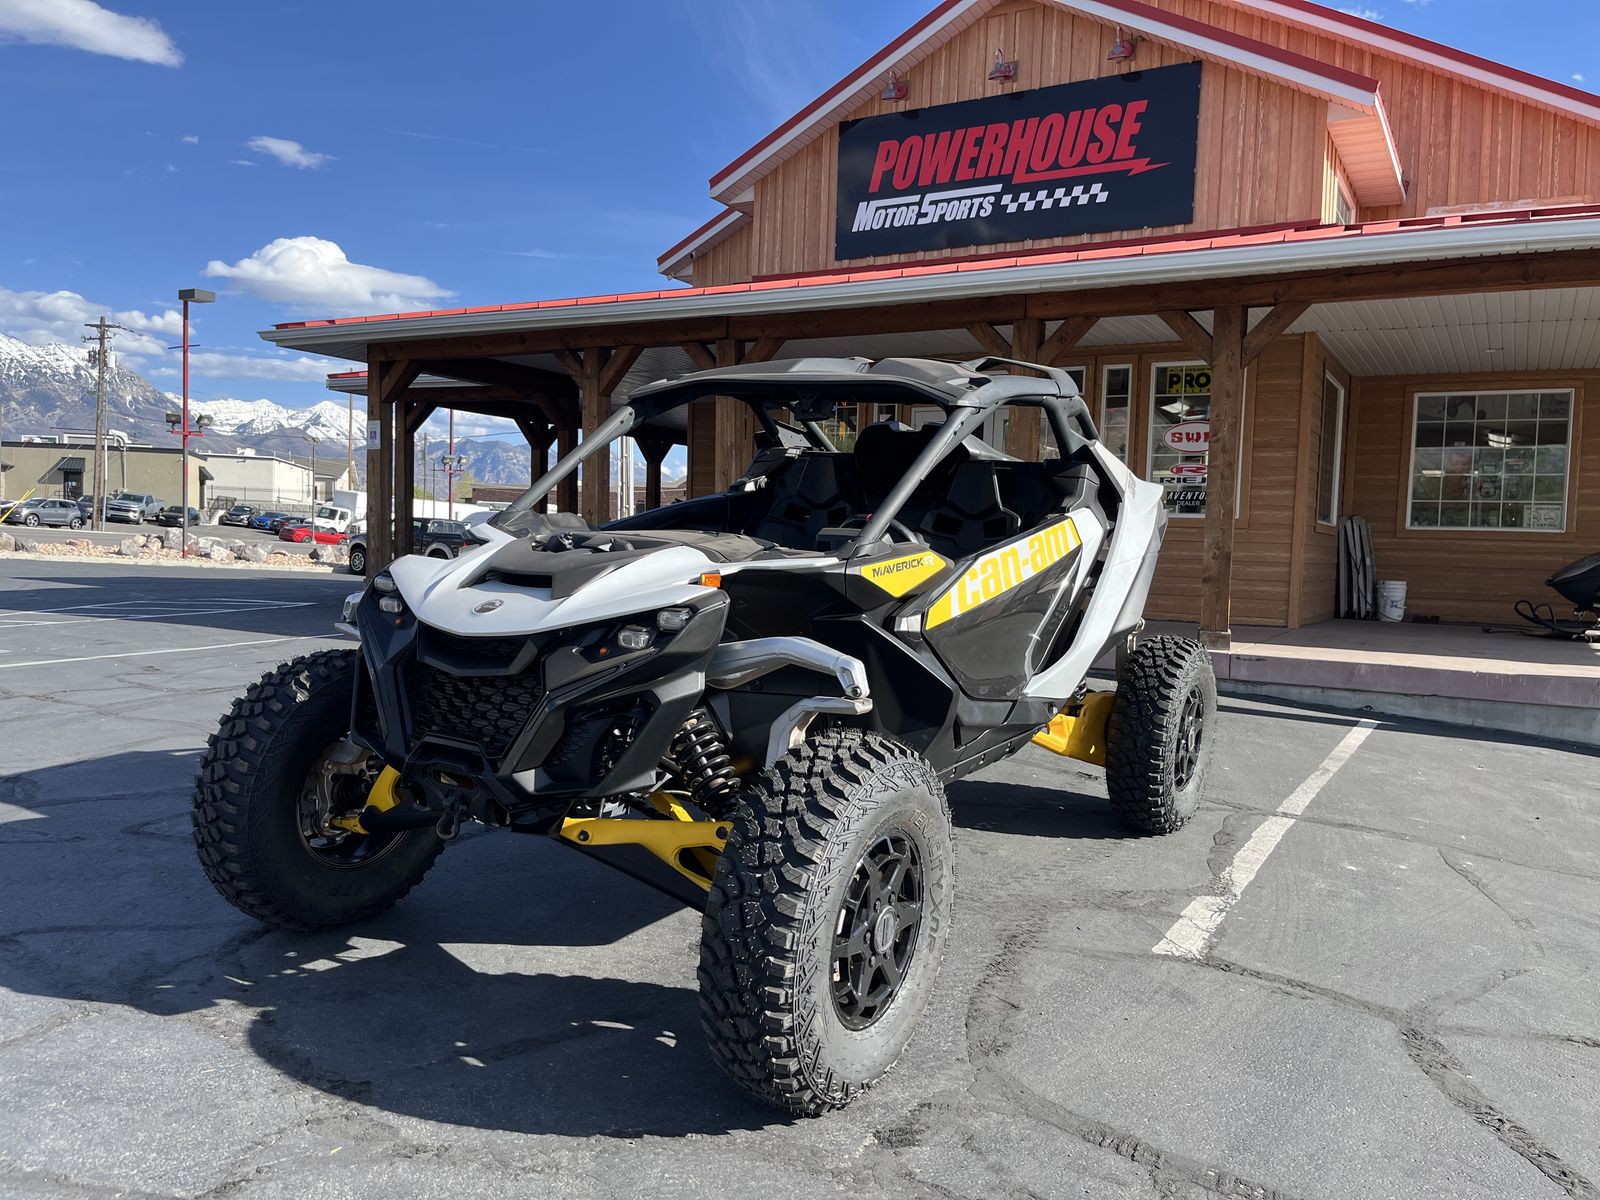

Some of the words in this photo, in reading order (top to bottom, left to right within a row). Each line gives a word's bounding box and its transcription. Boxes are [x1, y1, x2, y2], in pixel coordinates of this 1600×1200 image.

[868, 99, 1149, 193] POWERHOUSE
[1168, 372, 1211, 389] PRO
[1160, 476, 1206, 484] RIEJ
[1167, 491, 1208, 500] AVENTO
[871, 557, 923, 578] MAVERICK
[957, 522, 1071, 613] can-am
